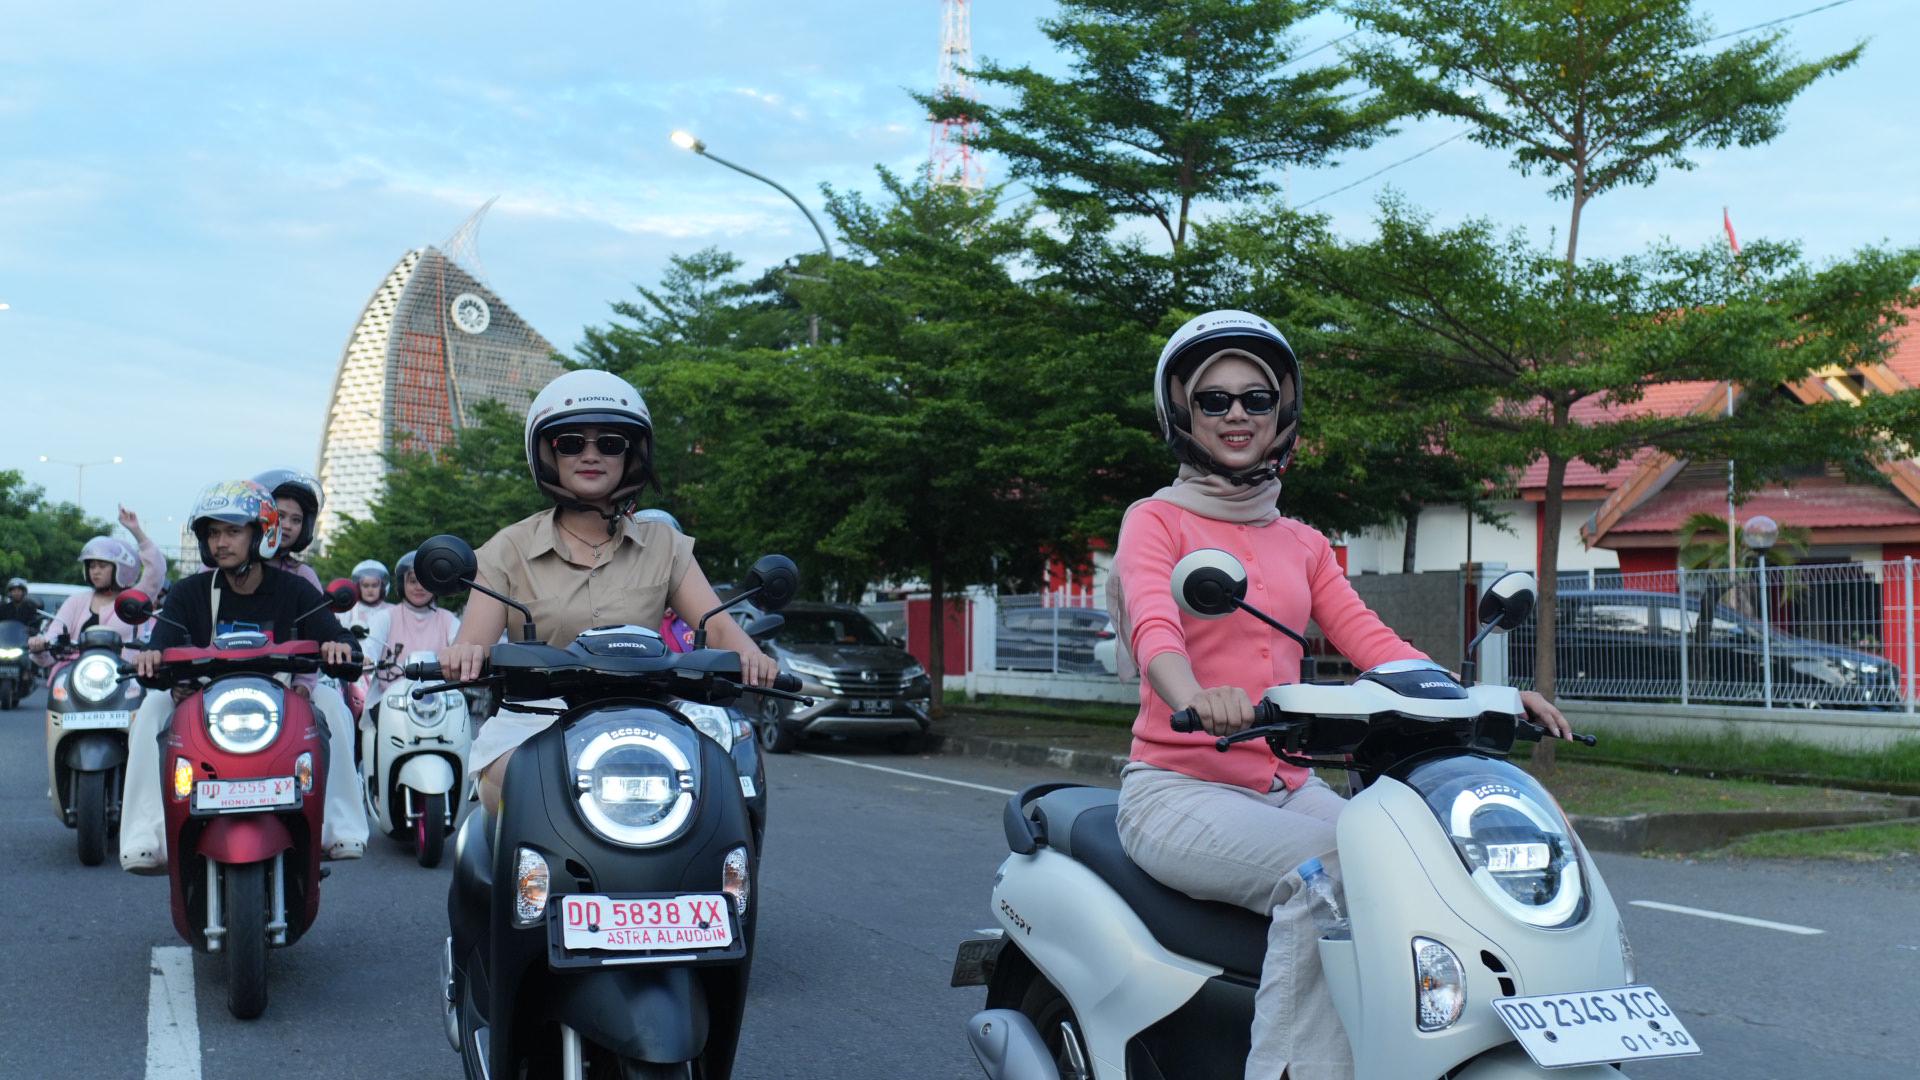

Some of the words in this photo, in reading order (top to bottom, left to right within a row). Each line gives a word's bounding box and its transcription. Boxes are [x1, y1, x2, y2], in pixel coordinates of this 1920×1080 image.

[608, 642, 647, 650] HONDA
[1420, 681, 1458, 689] HONDA
[610, 727, 657, 739] SCOOPY
[228, 782, 266, 794] 2555
[274, 780, 293, 792] XX
[1475, 784, 1518, 798] SCOOPY
[221, 799, 256, 807] HONDA
[568, 901, 600, 926] DD
[613, 902, 681, 927] 5838
[688, 901, 722, 925] XX
[1001, 899, 1031, 936] SCOOPY
[607, 930, 652, 945] ASTRA
[657, 927, 726, 944] ALAUDDIN
[1501, 1002, 1547, 1031] DD
[1543, 996, 1617, 1027] 2346
[1612, 991, 1670, 1020] XCC
